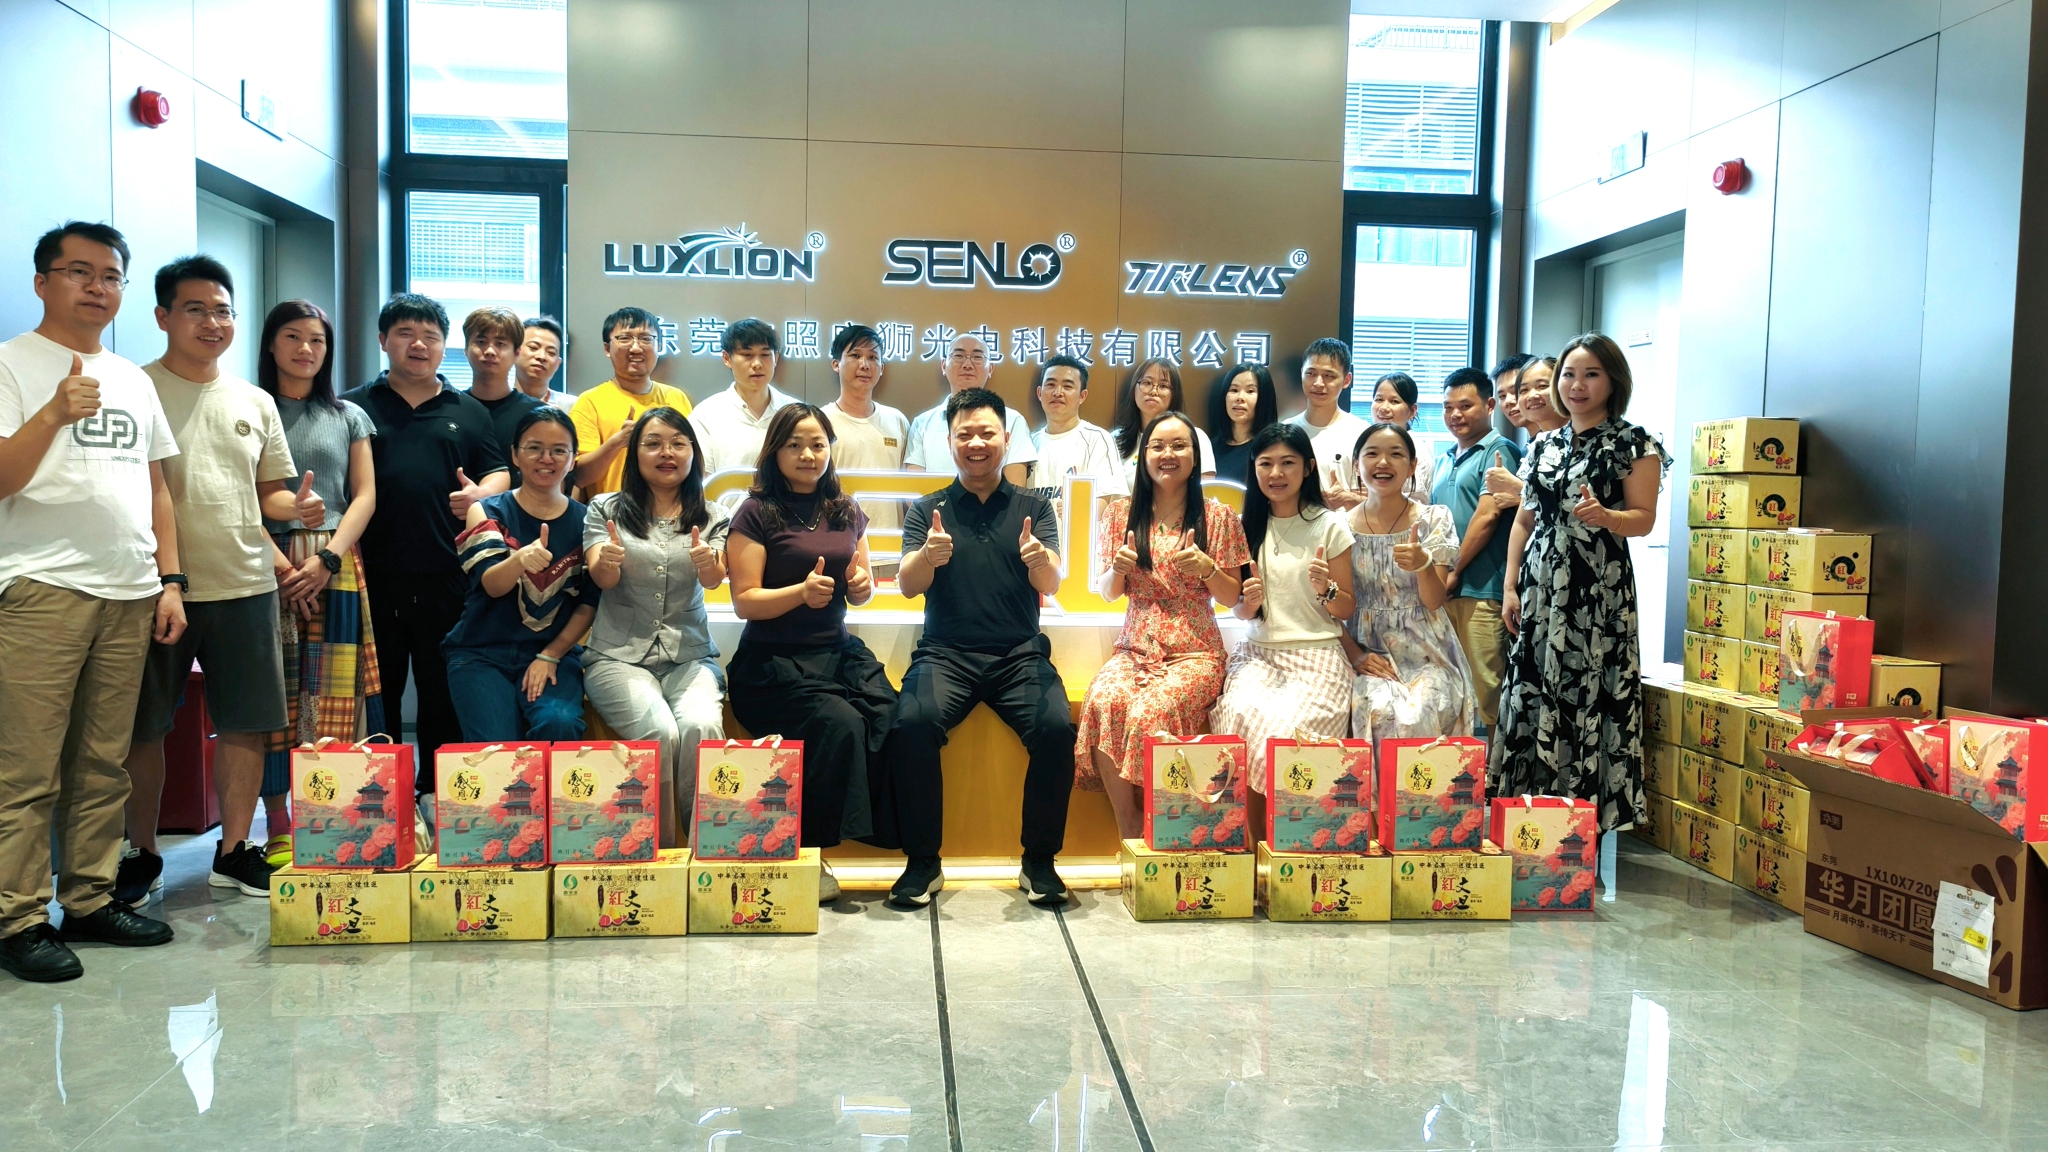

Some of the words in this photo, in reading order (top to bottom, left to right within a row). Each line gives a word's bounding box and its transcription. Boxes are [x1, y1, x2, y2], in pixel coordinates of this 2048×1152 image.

[604, 224, 815, 282] LUXLION
[882, 238, 1062, 289] SENLO
[1125, 262, 1297, 297] TIRLENS
[1822, 853, 1838, 866] 东莞
[1185, 877, 1198, 891] 紅
[1321, 879, 1335, 892] 紅
[1441, 878, 1456, 890] 紅
[467, 895, 481, 909] 紅
[609, 891, 624, 905] 紅
[742, 888, 756, 903] 紅
[1819, 869, 1936, 932] 华月团圆
[328, 898, 344, 913] 紅
